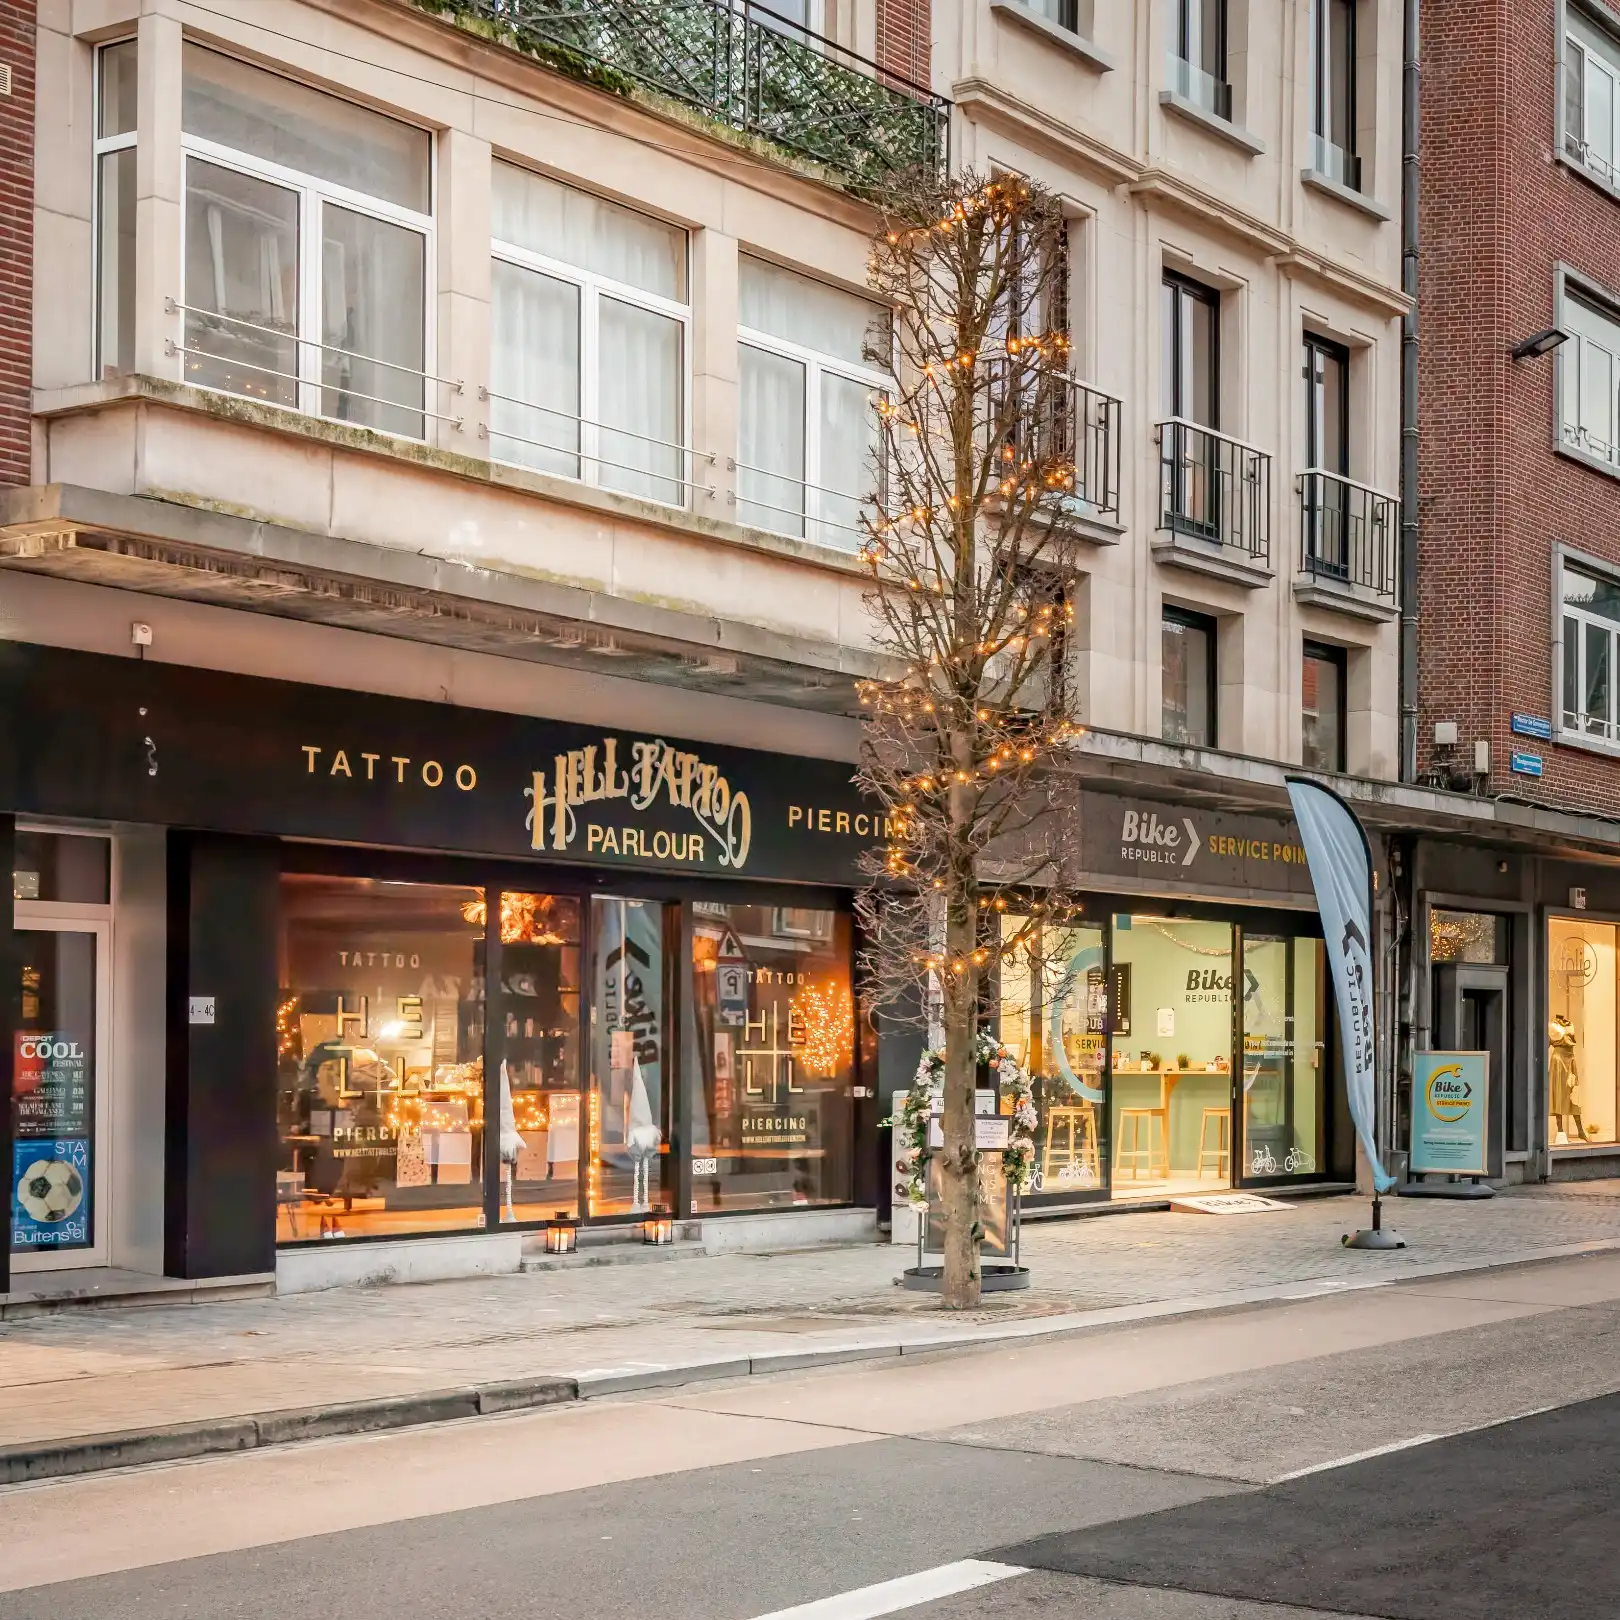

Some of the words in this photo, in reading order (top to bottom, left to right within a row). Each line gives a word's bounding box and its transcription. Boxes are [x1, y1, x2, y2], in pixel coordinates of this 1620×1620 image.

[301, 745, 478, 792] TATTOO
[523, 737, 629, 850] HELL
[630, 739, 752, 869] TATTOO
[1121, 810, 1182, 847] Bike
[587, 824, 705, 862] PARLOUR
[1208, 834, 1269, 861] SERVICE
[1273, 843, 1306, 865] POIN
[1121, 847, 1177, 865] REPUBLIC
[339, 951, 421, 969] TATTOO
[746, 971, 805, 985] TATTOO
[20, 1042, 84, 1059] COOL
[52, 1060, 84, 1068] FESTIVAL
[1434, 1081, 1462, 1093] Bike
[742, 1117, 807, 1131] PIERCING
